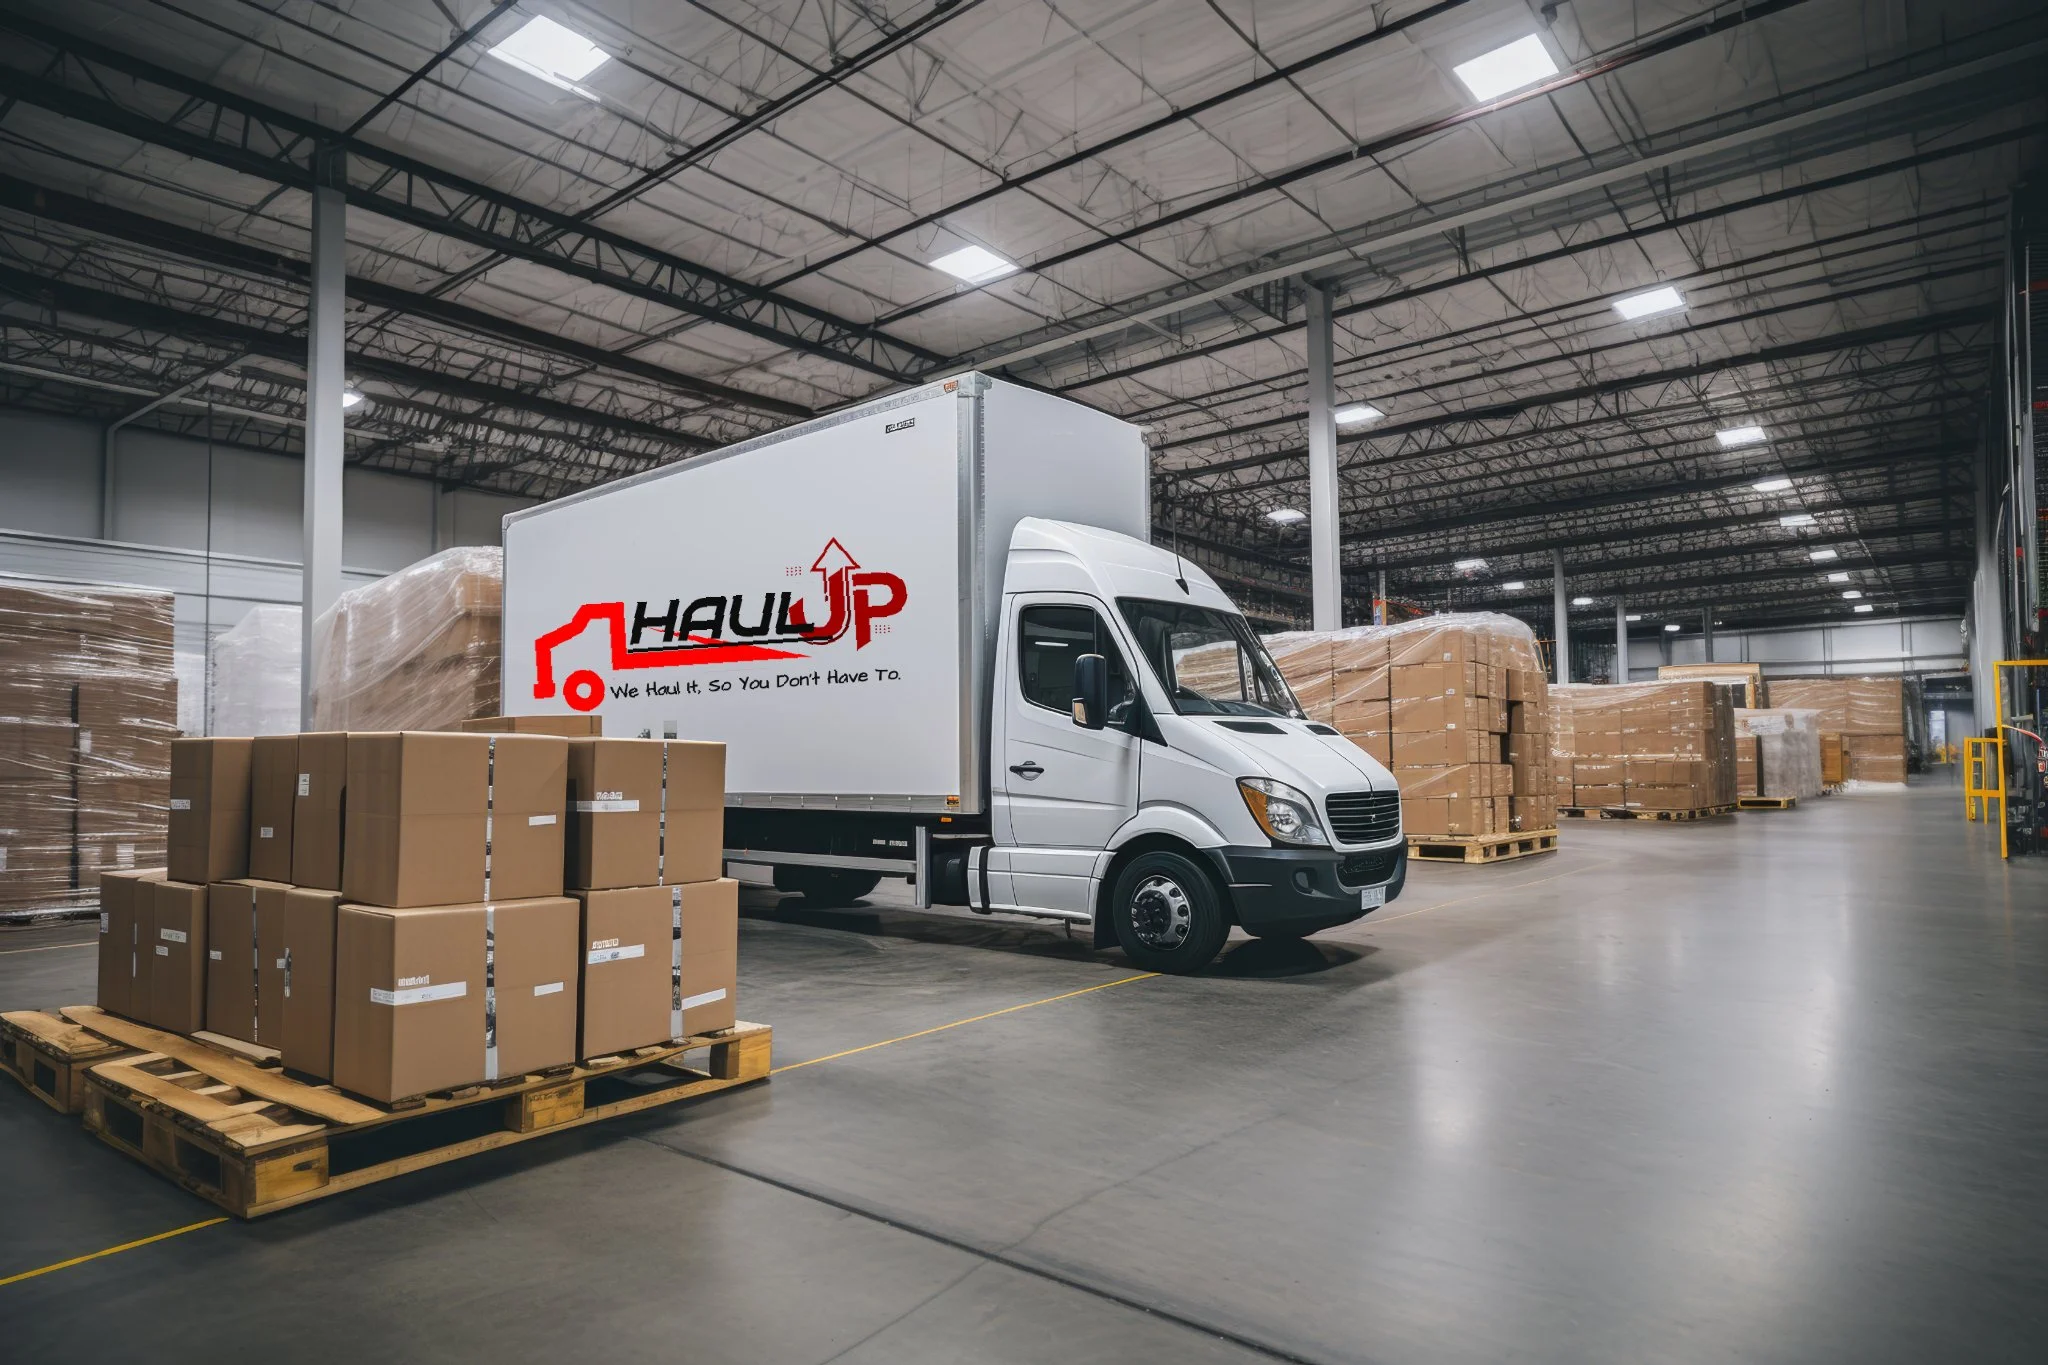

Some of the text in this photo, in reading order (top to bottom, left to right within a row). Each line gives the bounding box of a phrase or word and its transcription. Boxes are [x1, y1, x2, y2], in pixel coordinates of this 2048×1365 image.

[610, 668, 902, 699] We Haul It, So You Don't Have To.
